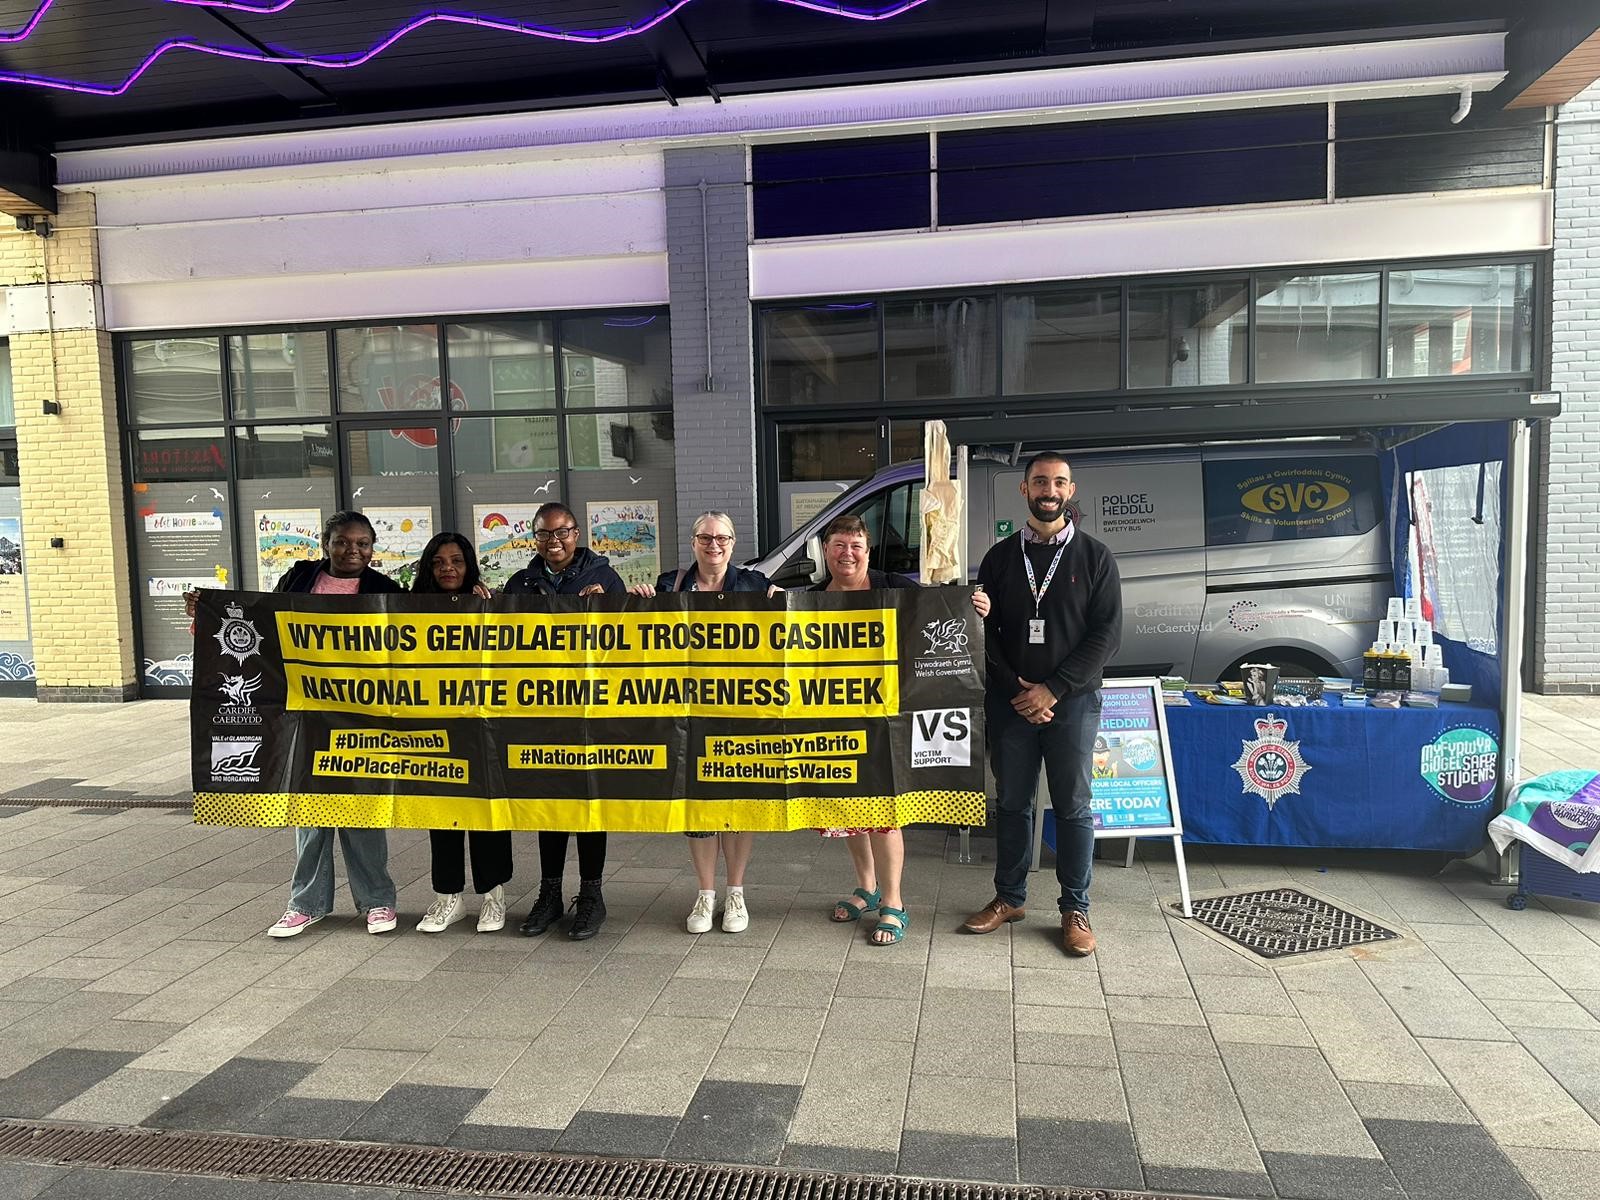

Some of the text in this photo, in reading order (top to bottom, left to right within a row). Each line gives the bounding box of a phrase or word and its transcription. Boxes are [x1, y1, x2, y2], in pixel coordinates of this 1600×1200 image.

[1325, 471, 1352, 484] Cymru
[1102, 493, 1148, 505] POLICE
[1269, 483, 1322, 512] SVC
[1102, 503, 1154, 516] HEDDLU
[1240, 511, 1262, 523] Skills
[1273, 516, 1324, 527] Volunteering
[1326, 507, 1352, 521] Cymru
[287, 622, 417, 651] WYTHNOS
[426, 624, 631, 652] GENEDLAETHOL
[637, 623, 760, 651] TROSEDD
[769, 621, 886, 650] CASINEB
[914, 658, 972, 669] Llywodraeth Cymru
[915, 667, 972, 678] Welsh Government
[301, 675, 884, 706] NATIONAL HATE CRIME AWARENESS WEEK
[218, 706, 257, 715] CARDIFF
[212, 716, 263, 724] CAERDYDD
[916, 710, 969, 741] VS
[1101, 717, 1149, 729] HEDDIW
[335, 732, 444, 749] #DimCasineb
[712, 735, 860, 757] #CasinebYnBrifo
[519, 748, 654, 766] #NationalHCAW
[914, 750, 942, 758] VICTIM
[914, 756, 952, 766] SUPPORT
[1462, 752, 1497, 771] SAFER
[318, 755, 465, 780] #NoPlaceForHate
[702, 762, 852, 780] #HateHurtsWales
[1437, 763, 1496, 789] STUDENTS
[1090, 796, 1162, 811] ERE TODAY
